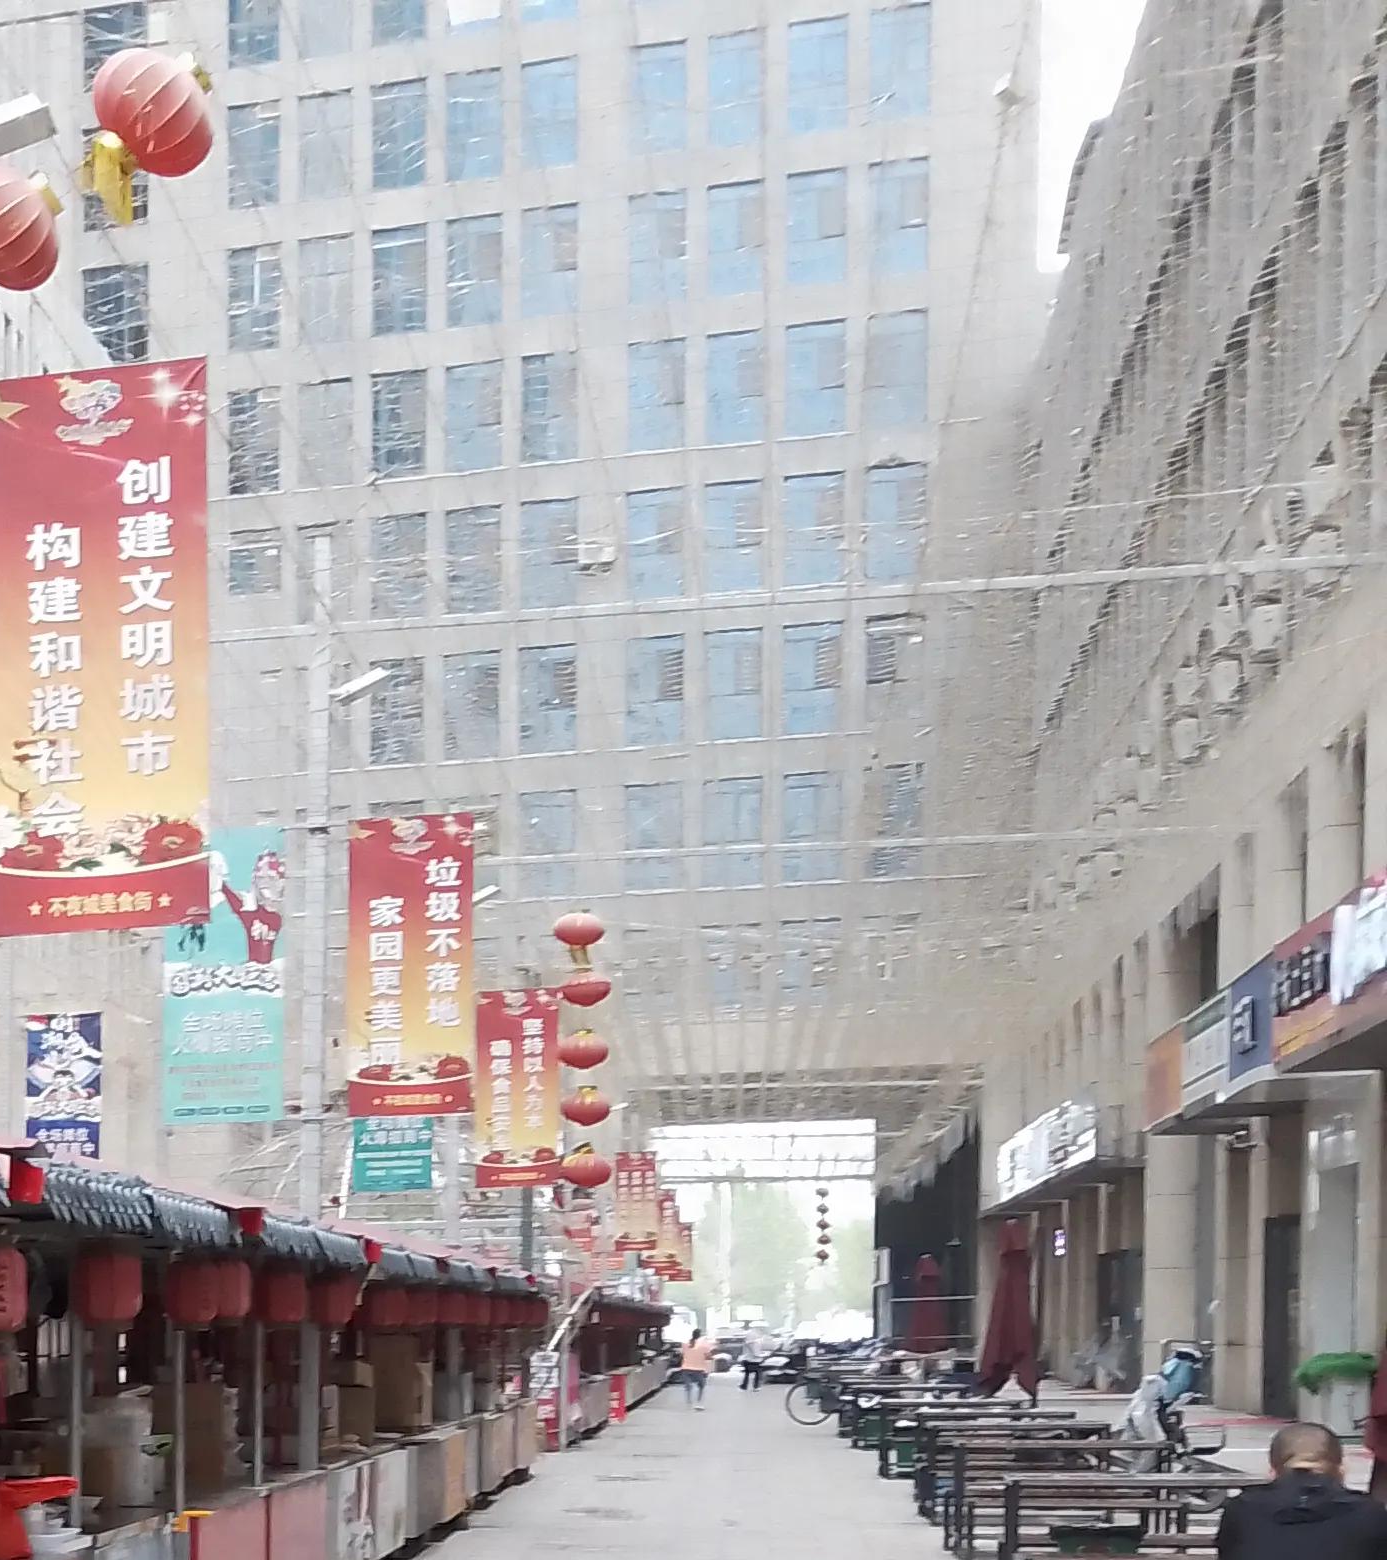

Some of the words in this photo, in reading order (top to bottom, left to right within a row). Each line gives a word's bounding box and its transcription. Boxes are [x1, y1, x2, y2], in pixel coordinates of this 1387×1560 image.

[25, 522, 83, 838] 构建和谐社会
[115, 458, 178, 776] 创建文明城市
[47, 892, 154, 918] 不夜城美食街
[366, 894, 406, 1066] 家园更美丽
[424, 856, 462, 1029] 垃圾不落地
